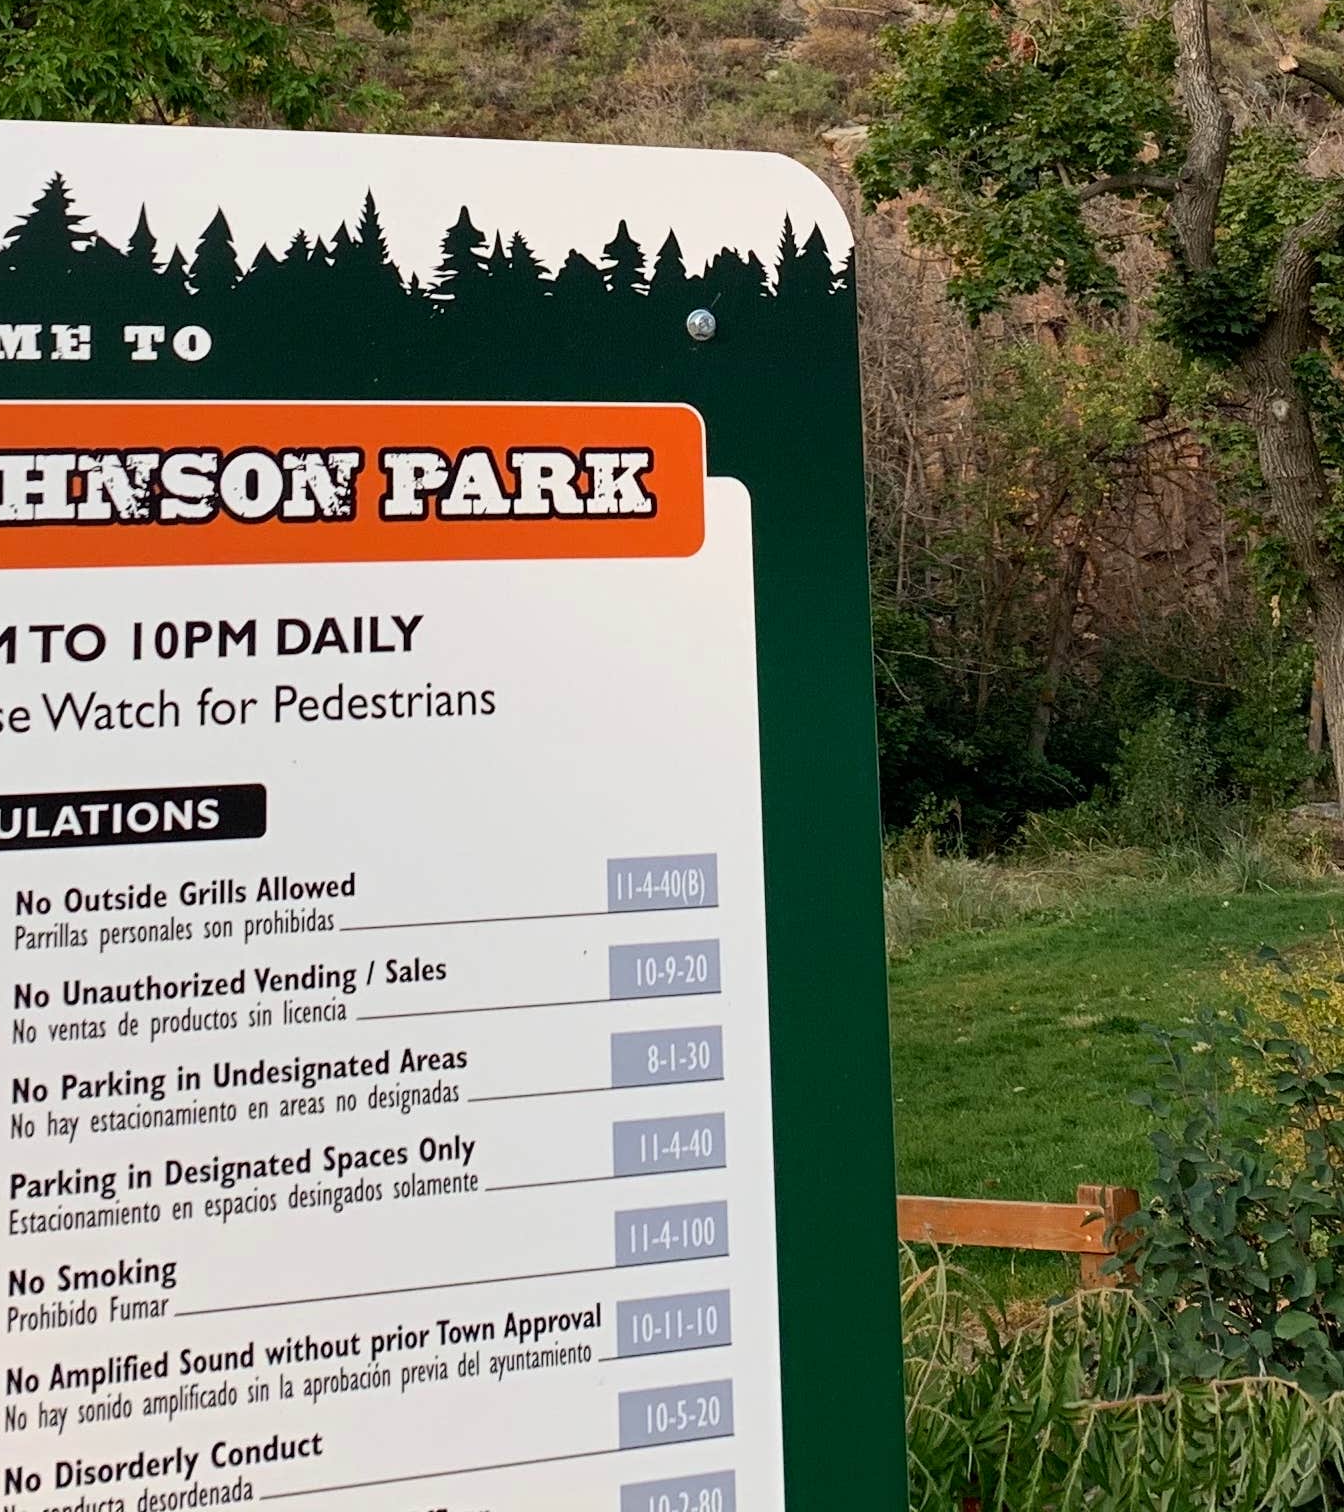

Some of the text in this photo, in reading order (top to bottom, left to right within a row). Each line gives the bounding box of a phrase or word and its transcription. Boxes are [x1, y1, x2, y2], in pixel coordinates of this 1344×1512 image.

[123, 325, 212, 362] TO
[379, 448, 658, 524] PARK
[28, 623, 107, 664] TO
[133, 619, 257, 661] 10PM
[277, 614, 425, 656] DAILY
[41, 688, 180, 732] Watch
[196, 687, 258, 726] for
[274, 682, 496, 723] Pedestrians
[16, 871, 356, 916] No Outside Grills Allowed
[617, 868, 705, 905] 11-4-40(B)
[14, 907, 335, 954] Parrillas personales son prohibidas
[14, 957, 447, 1010] No Unauthorized Vending / Sales
[636, 954, 708, 986] 10-9-20
[12, 996, 347, 1044] No ventas de productos sin licencia
[12, 1048, 468, 1105] No Parking in Undesignated Areas
[647, 1040, 710, 1074] 8-1-30
[10, 1079, 460, 1144] No hay estacionamiento en areas no designadas
[10, 1134, 476, 1200] Parking in Designated Spaces Only
[640, 1128, 713, 1163] 11-4-40
[9, 1172, 479, 1236] Estacionamiento en espacios desingados solamente
[630, 1216, 715, 1253] 11-4-100
[8, 1257, 177, 1297] No Smoking
[7, 1295, 169, 1333] Prohibido Fumar
[632, 1305, 718, 1344] 10-11-10
[6, 1302, 601, 1396] No Amplified Sound without prior Town Approval
[4, 1340, 592, 1436] No hay sonido amplificado sin la aprobación previa del ayuntamiento
[647, 1395, 720, 1434] 10-5-20
[4, 1433, 323, 1496] No Disorderly Conduct
[137, 1475, 254, 1512] desordenada
